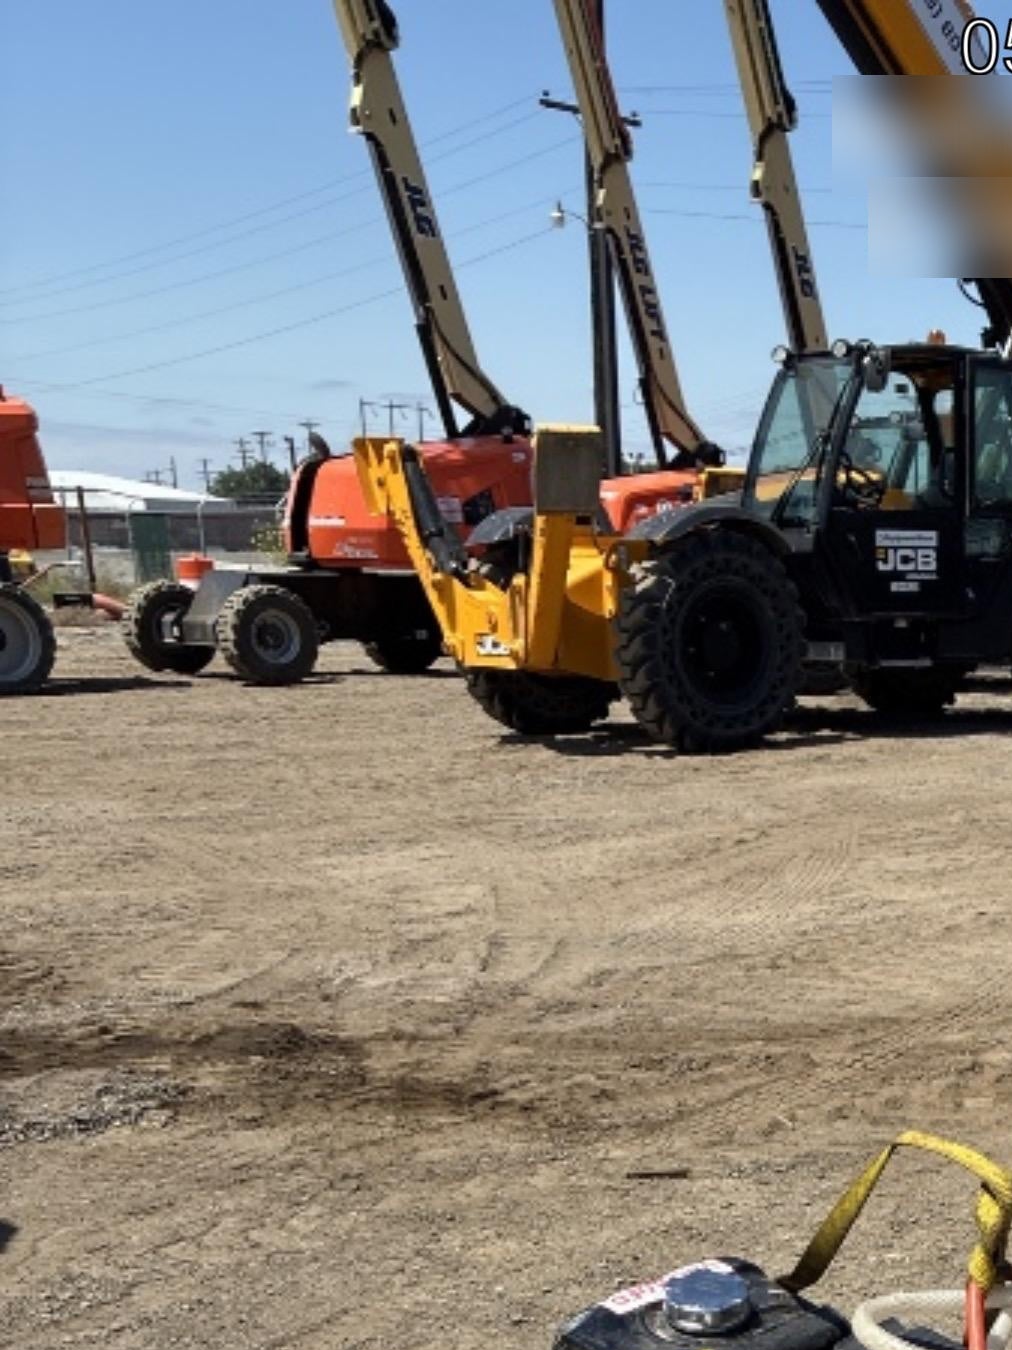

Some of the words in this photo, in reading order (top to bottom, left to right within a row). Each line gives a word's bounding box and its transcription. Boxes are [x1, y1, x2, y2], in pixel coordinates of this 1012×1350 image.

[402, 176, 436, 238] JLG
[792, 246, 817, 300] JLG
[876, 548, 937, 571] JCB
